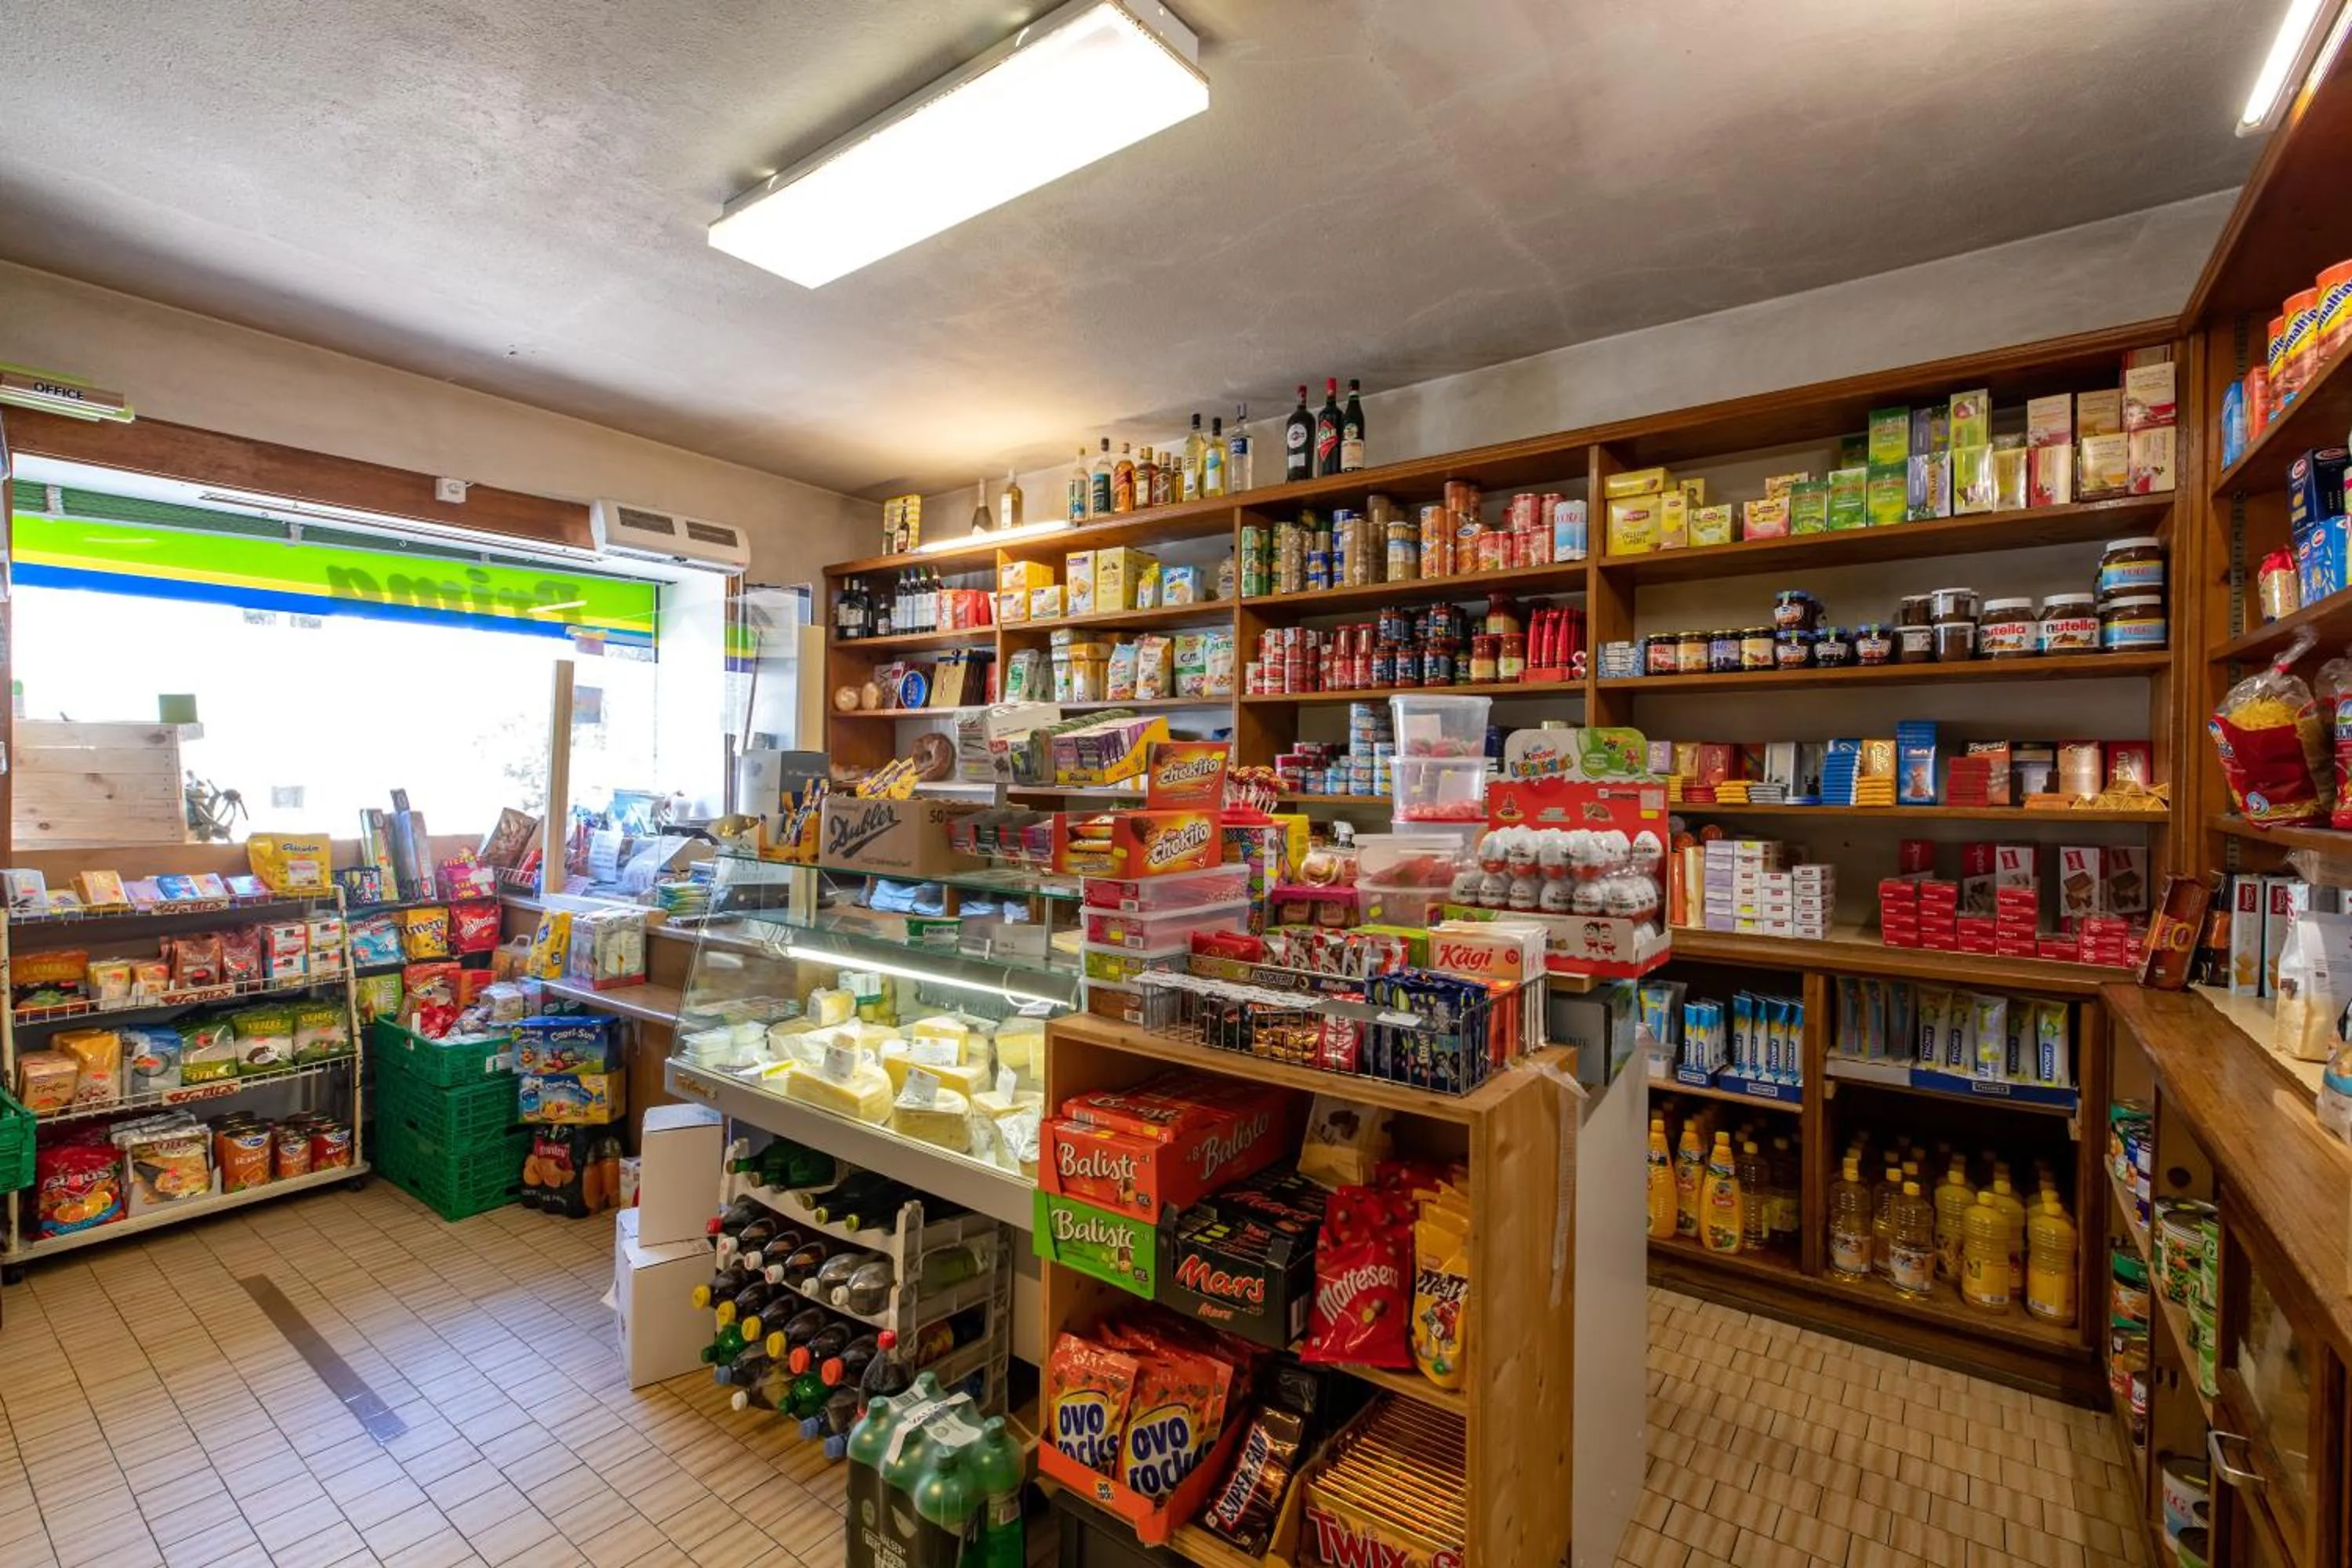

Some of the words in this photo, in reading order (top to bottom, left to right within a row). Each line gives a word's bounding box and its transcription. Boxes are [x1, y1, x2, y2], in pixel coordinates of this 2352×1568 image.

[33, 381, 85, 401] OFFICE
[2045, 619, 2096, 633] nutella
[1439, 944, 1493, 970] Kägi
[1175, 1254, 1265, 1303] Mars
[1316, 1265, 1399, 1326] Maltesers
